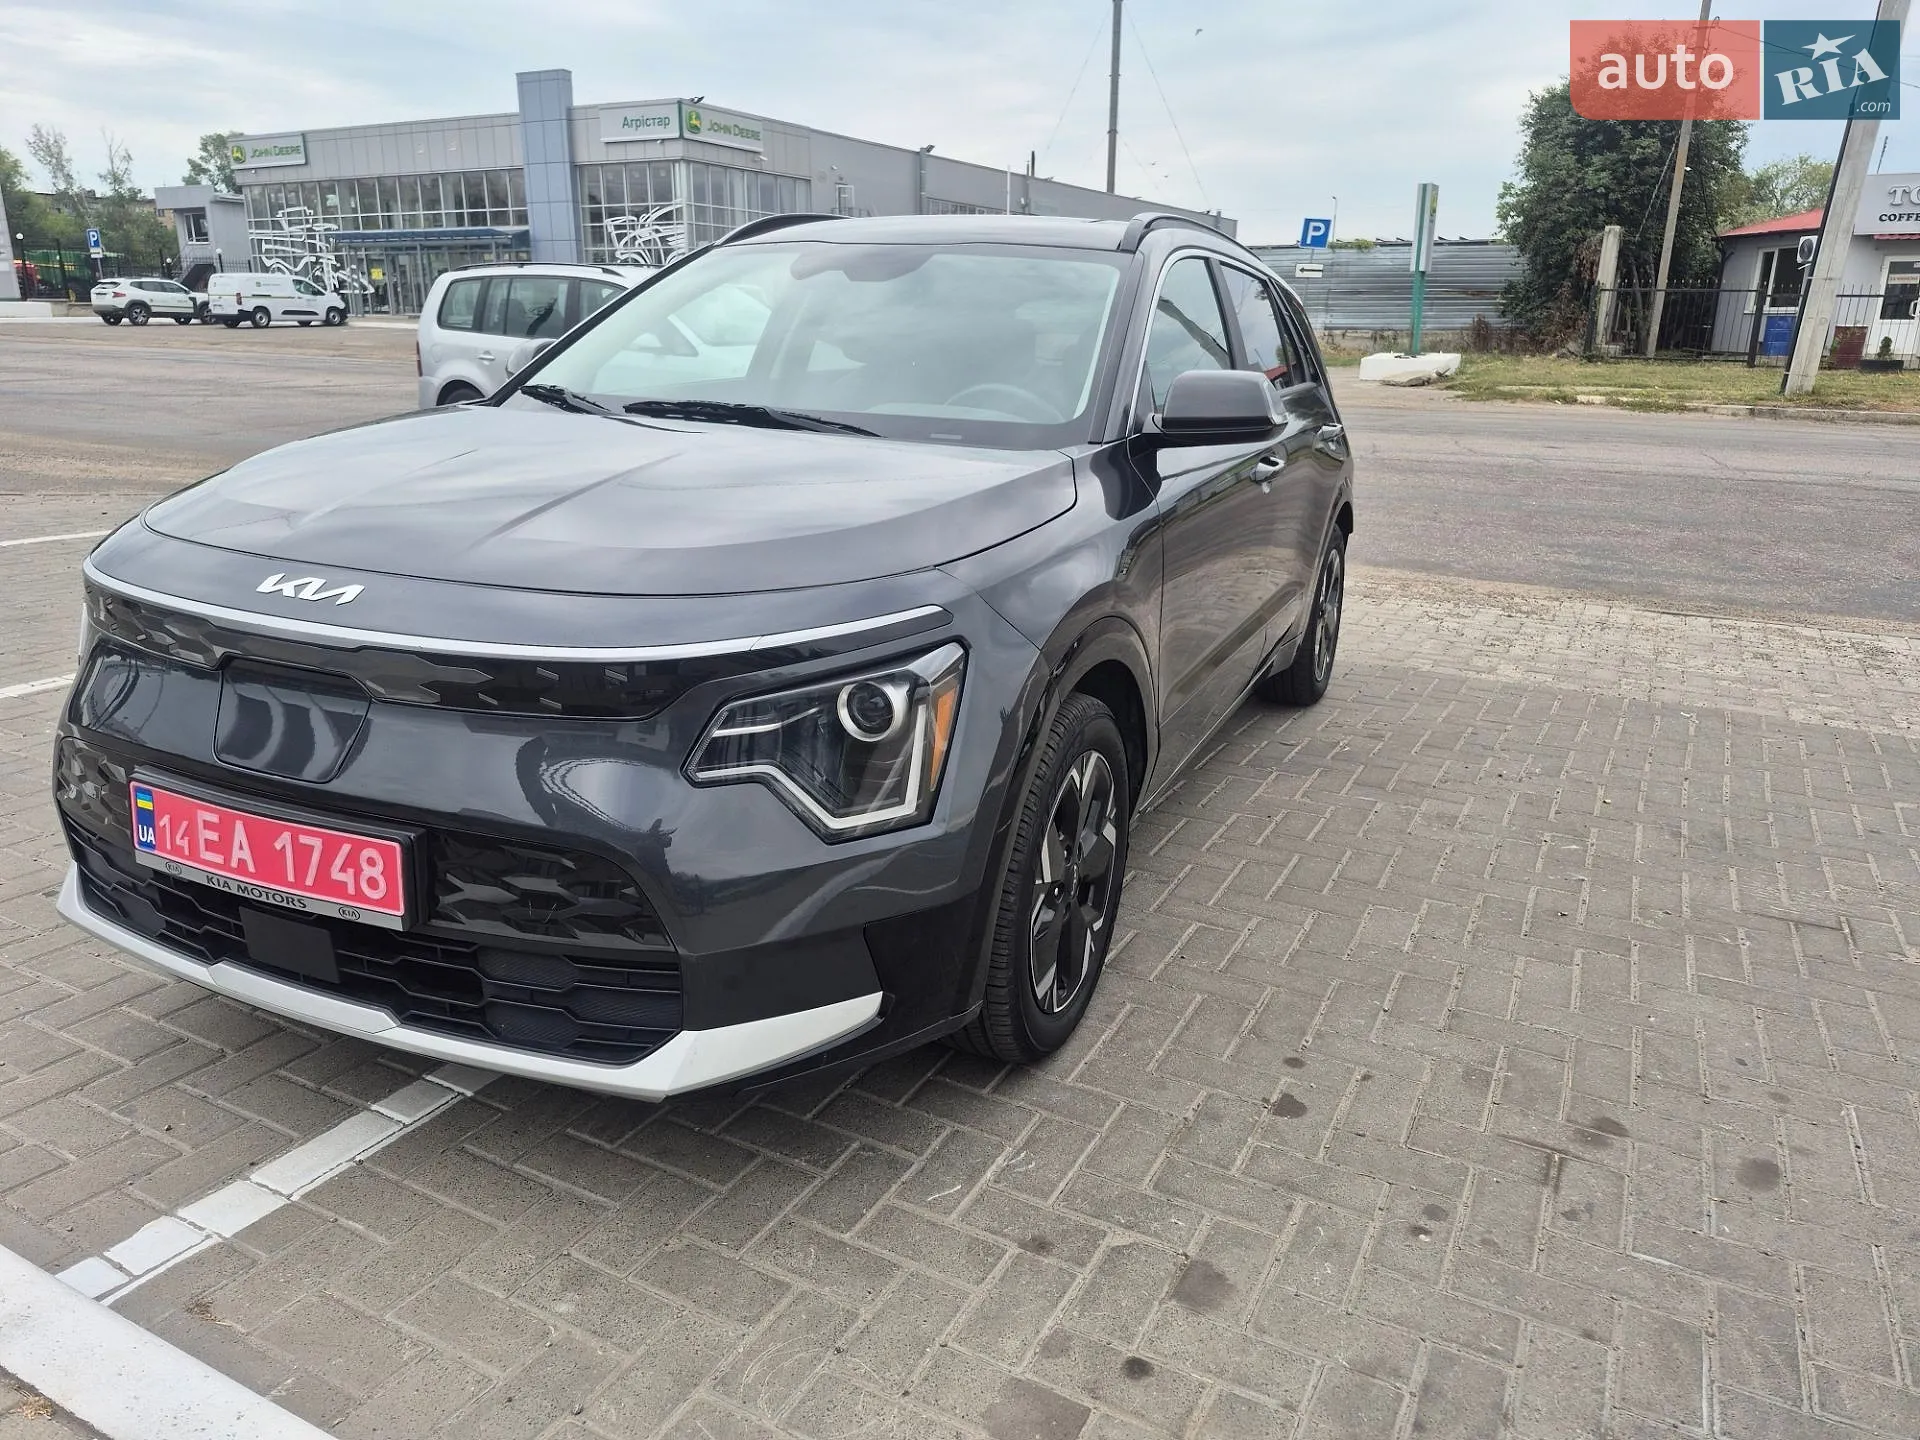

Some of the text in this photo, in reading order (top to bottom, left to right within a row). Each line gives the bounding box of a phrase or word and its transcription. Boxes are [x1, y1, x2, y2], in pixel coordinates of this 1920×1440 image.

[622, 115, 670, 132] Агрістар
[707, 119, 761, 141] JOHN DEERE
[89, 231, 98, 246] P
[1306, 222, 1326, 245] P
[256, 572, 365, 606] KIA
[138, 824, 156, 844] UA
[167, 863, 180, 874] KIA
[273, 831, 387, 900] 1748
[206, 874, 307, 909] KIA MOTORS
[341, 908, 358, 920] KIA
